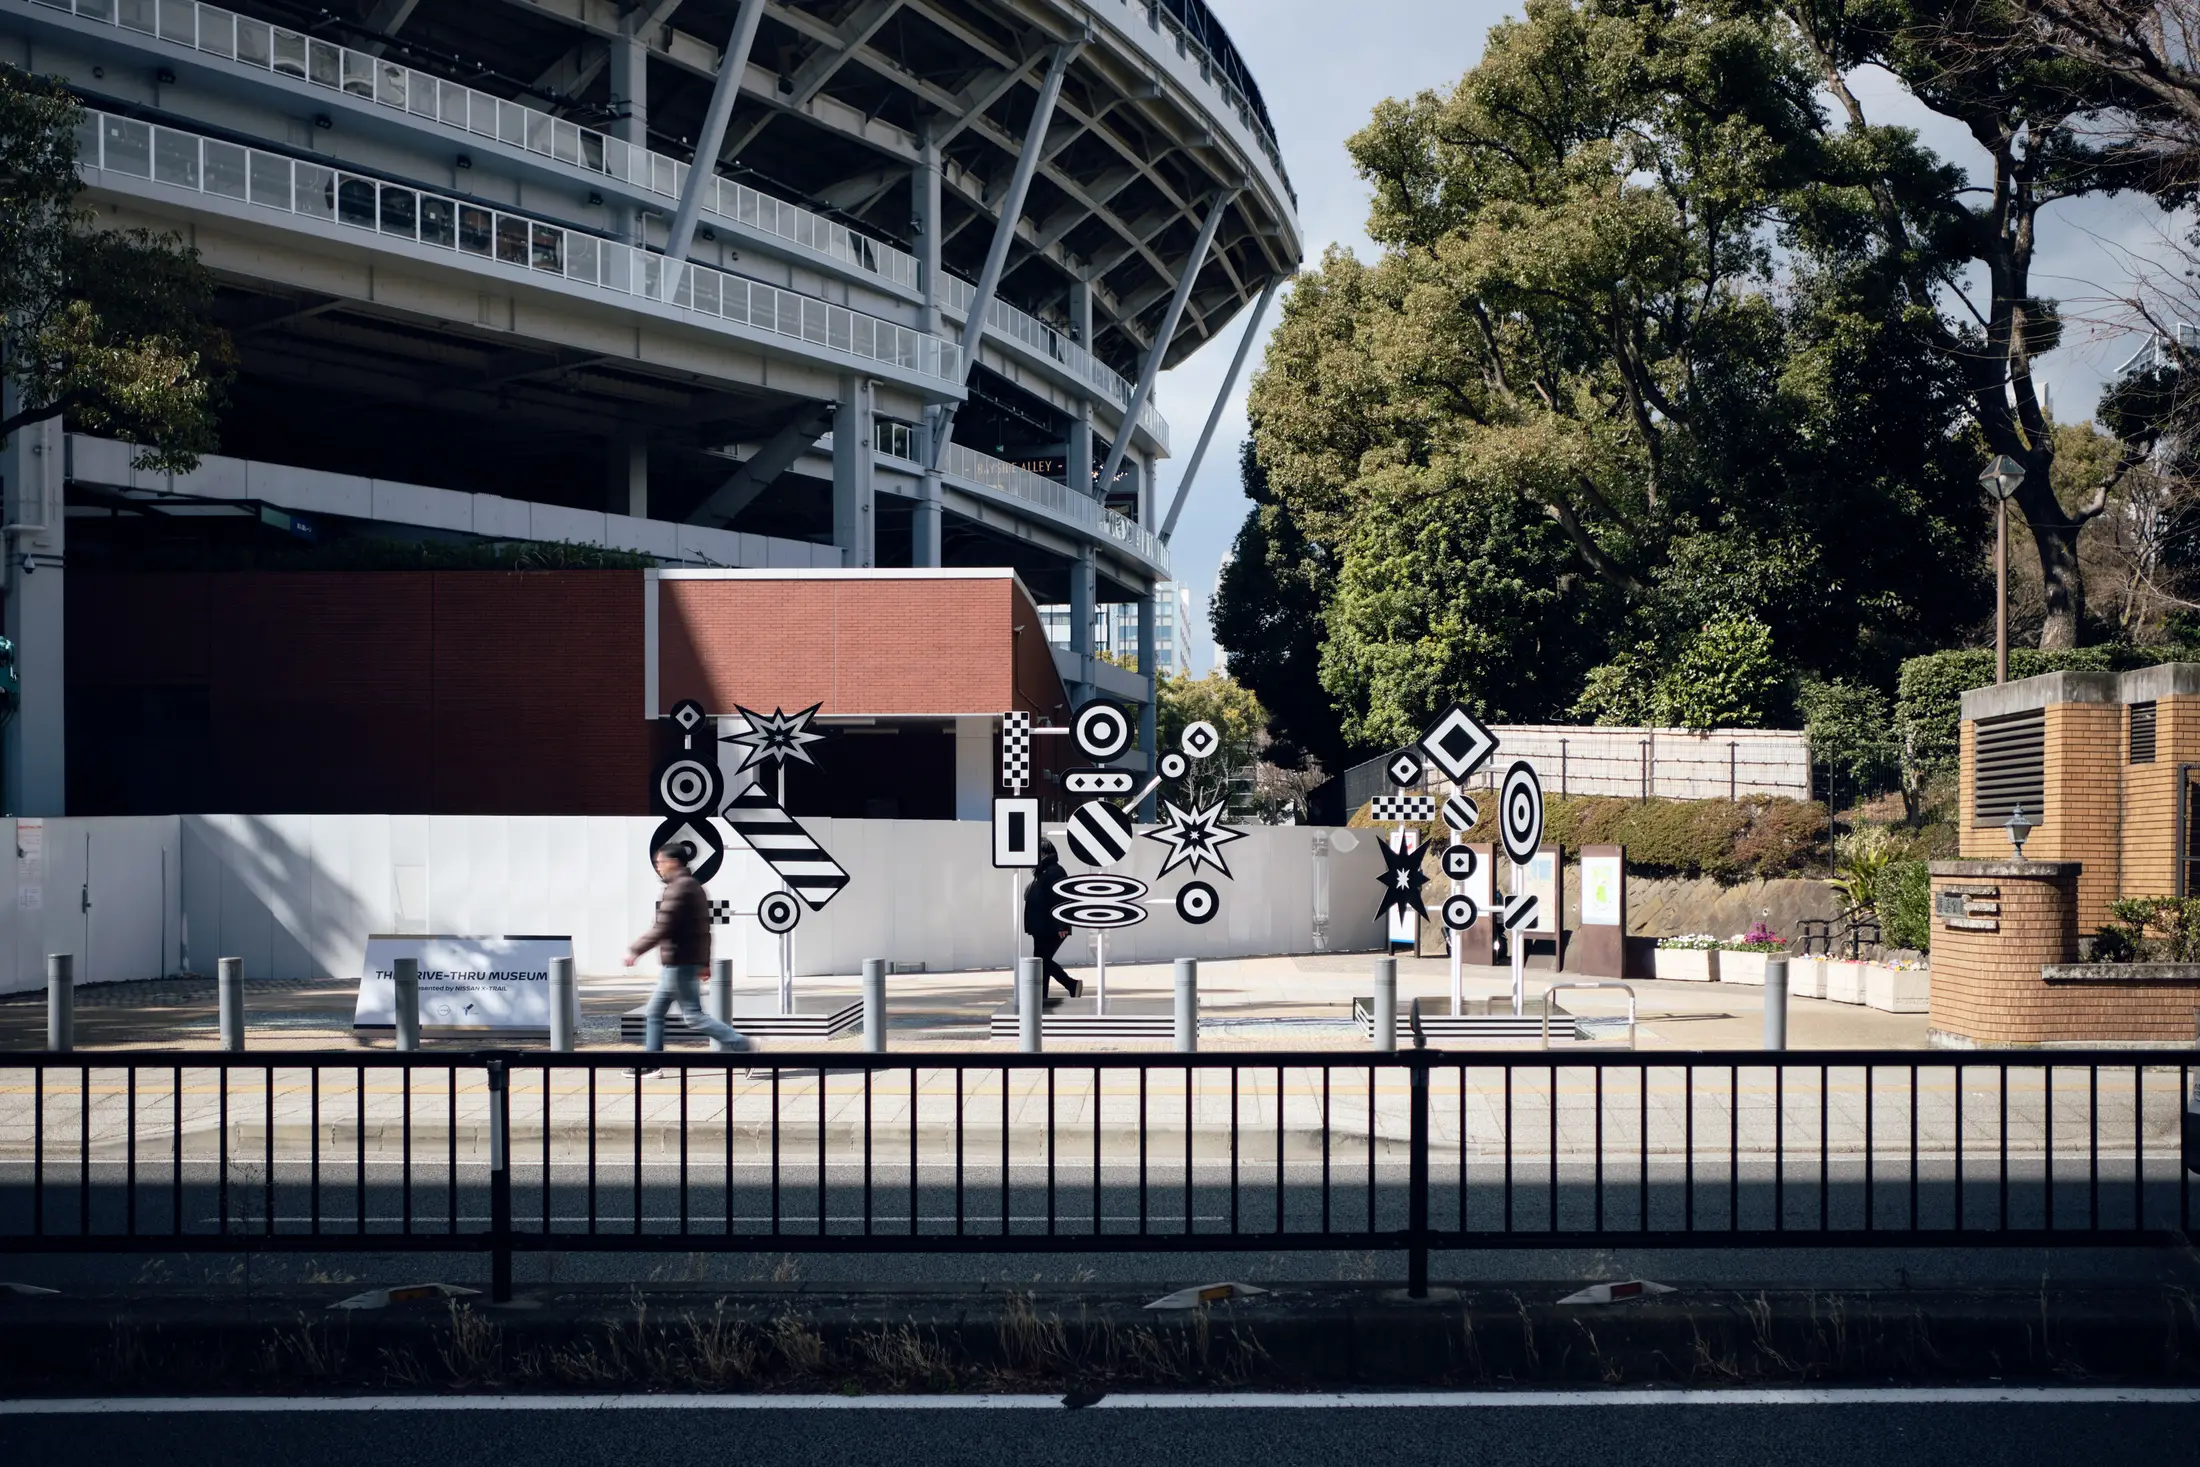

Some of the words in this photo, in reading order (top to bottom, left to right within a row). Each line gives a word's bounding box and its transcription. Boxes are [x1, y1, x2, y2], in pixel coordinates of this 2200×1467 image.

[1020, 461, 1052, 472] ALLEY
[376, 971, 395, 980] TH
[417, 971, 486, 981] RIVE-THRU
[488, 971, 548, 981] MUSEUM
[445, 985, 454, 993] by
